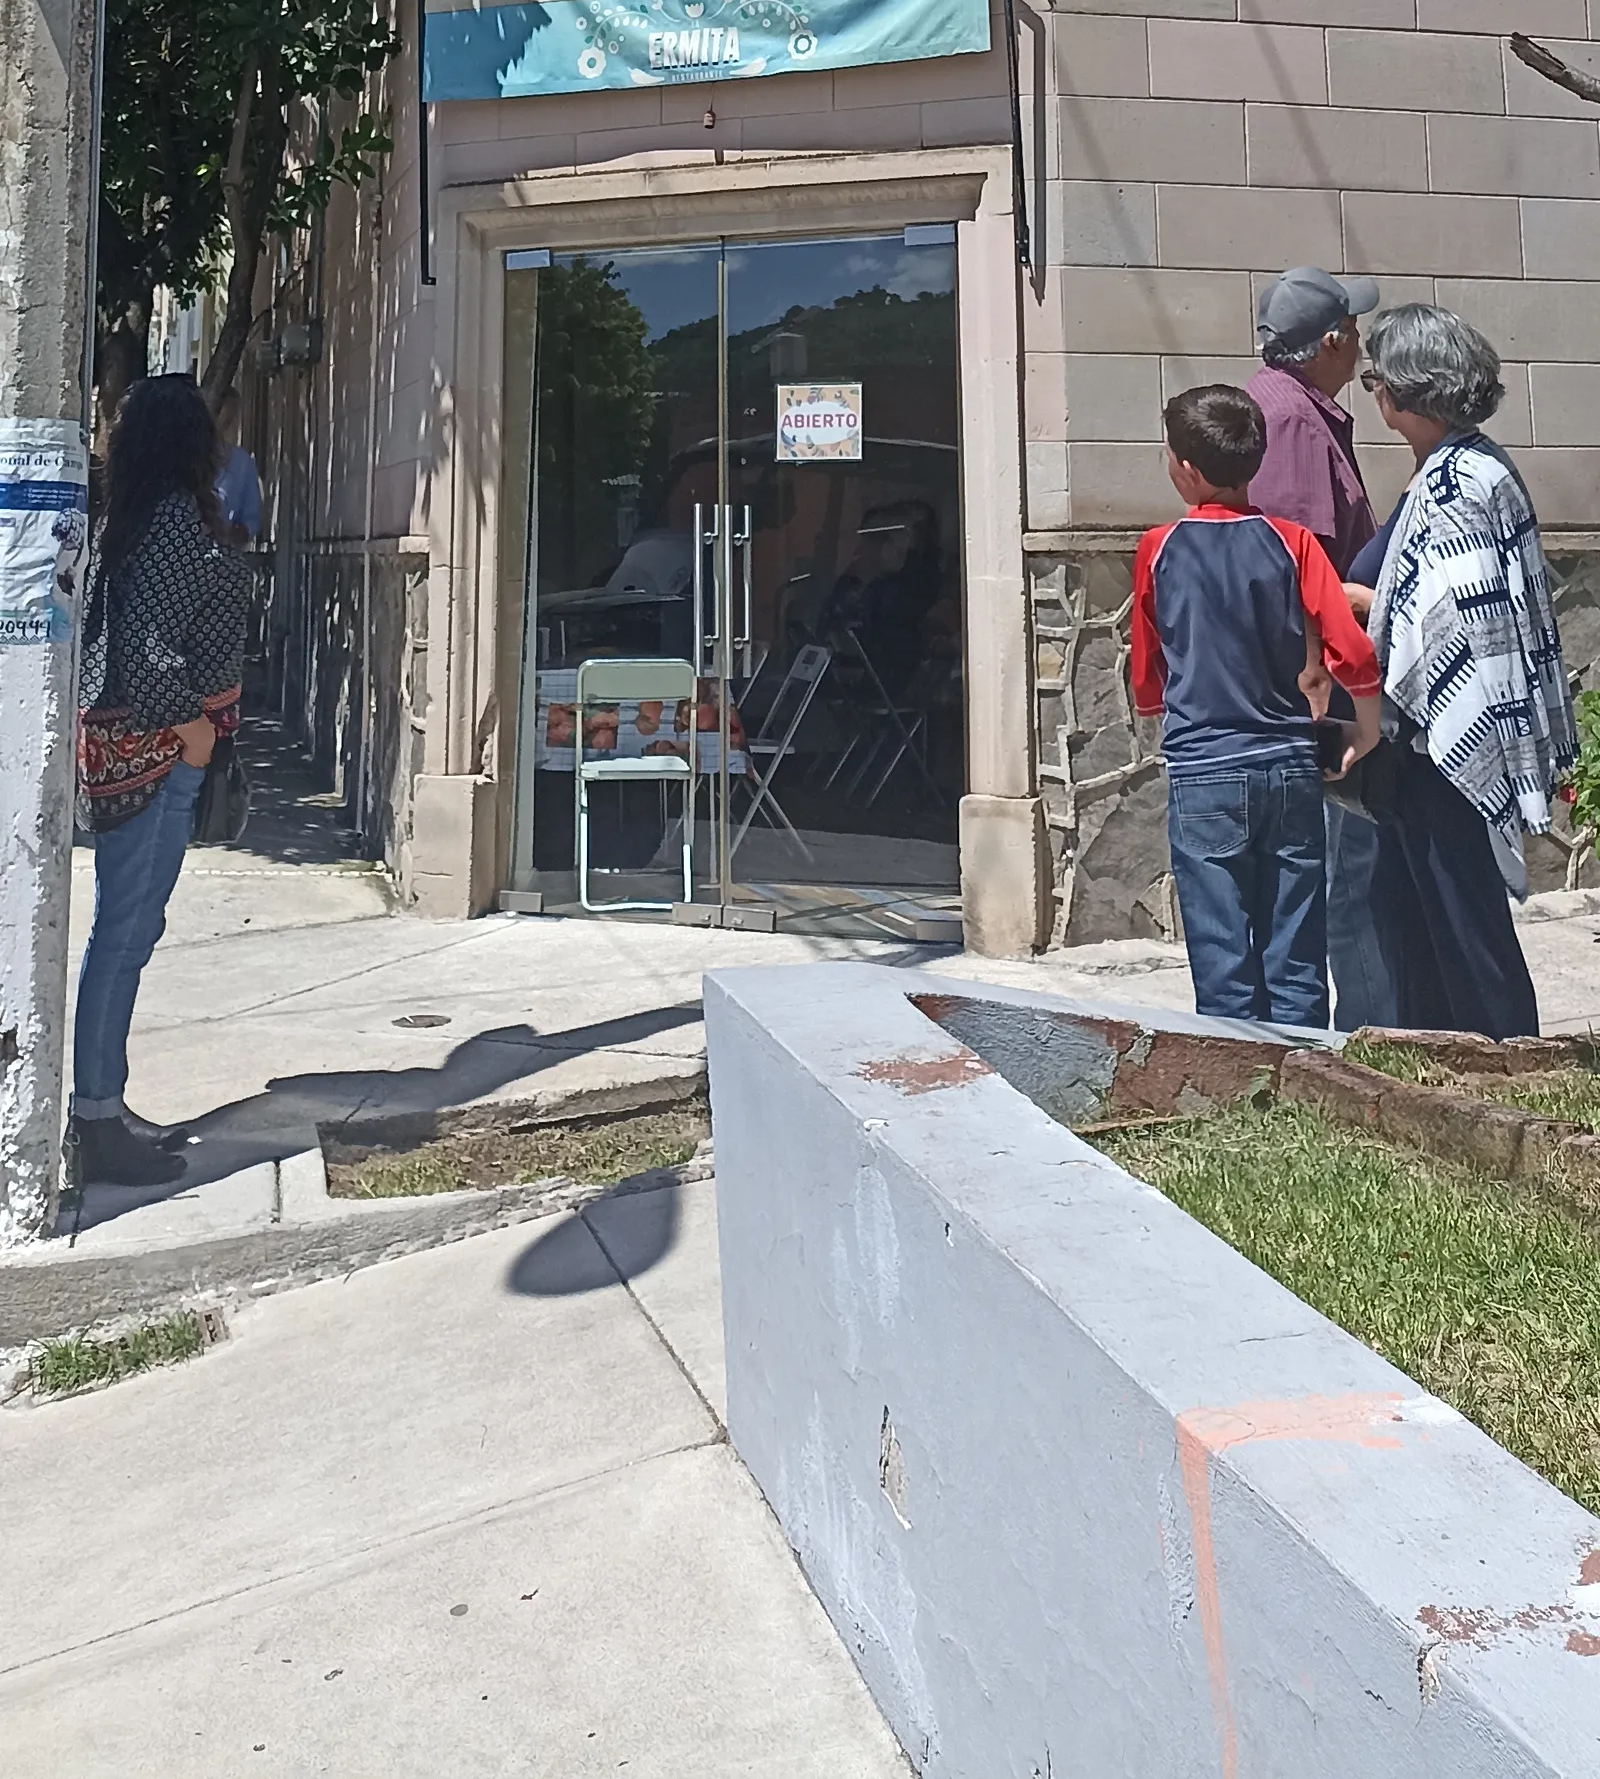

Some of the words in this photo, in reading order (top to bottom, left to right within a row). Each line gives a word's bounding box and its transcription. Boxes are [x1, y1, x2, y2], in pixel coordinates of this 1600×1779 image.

[648, 27, 740, 70] ERMITA
[781, 413, 858, 429] ABIERTO
[34, 454, 50, 467] de
